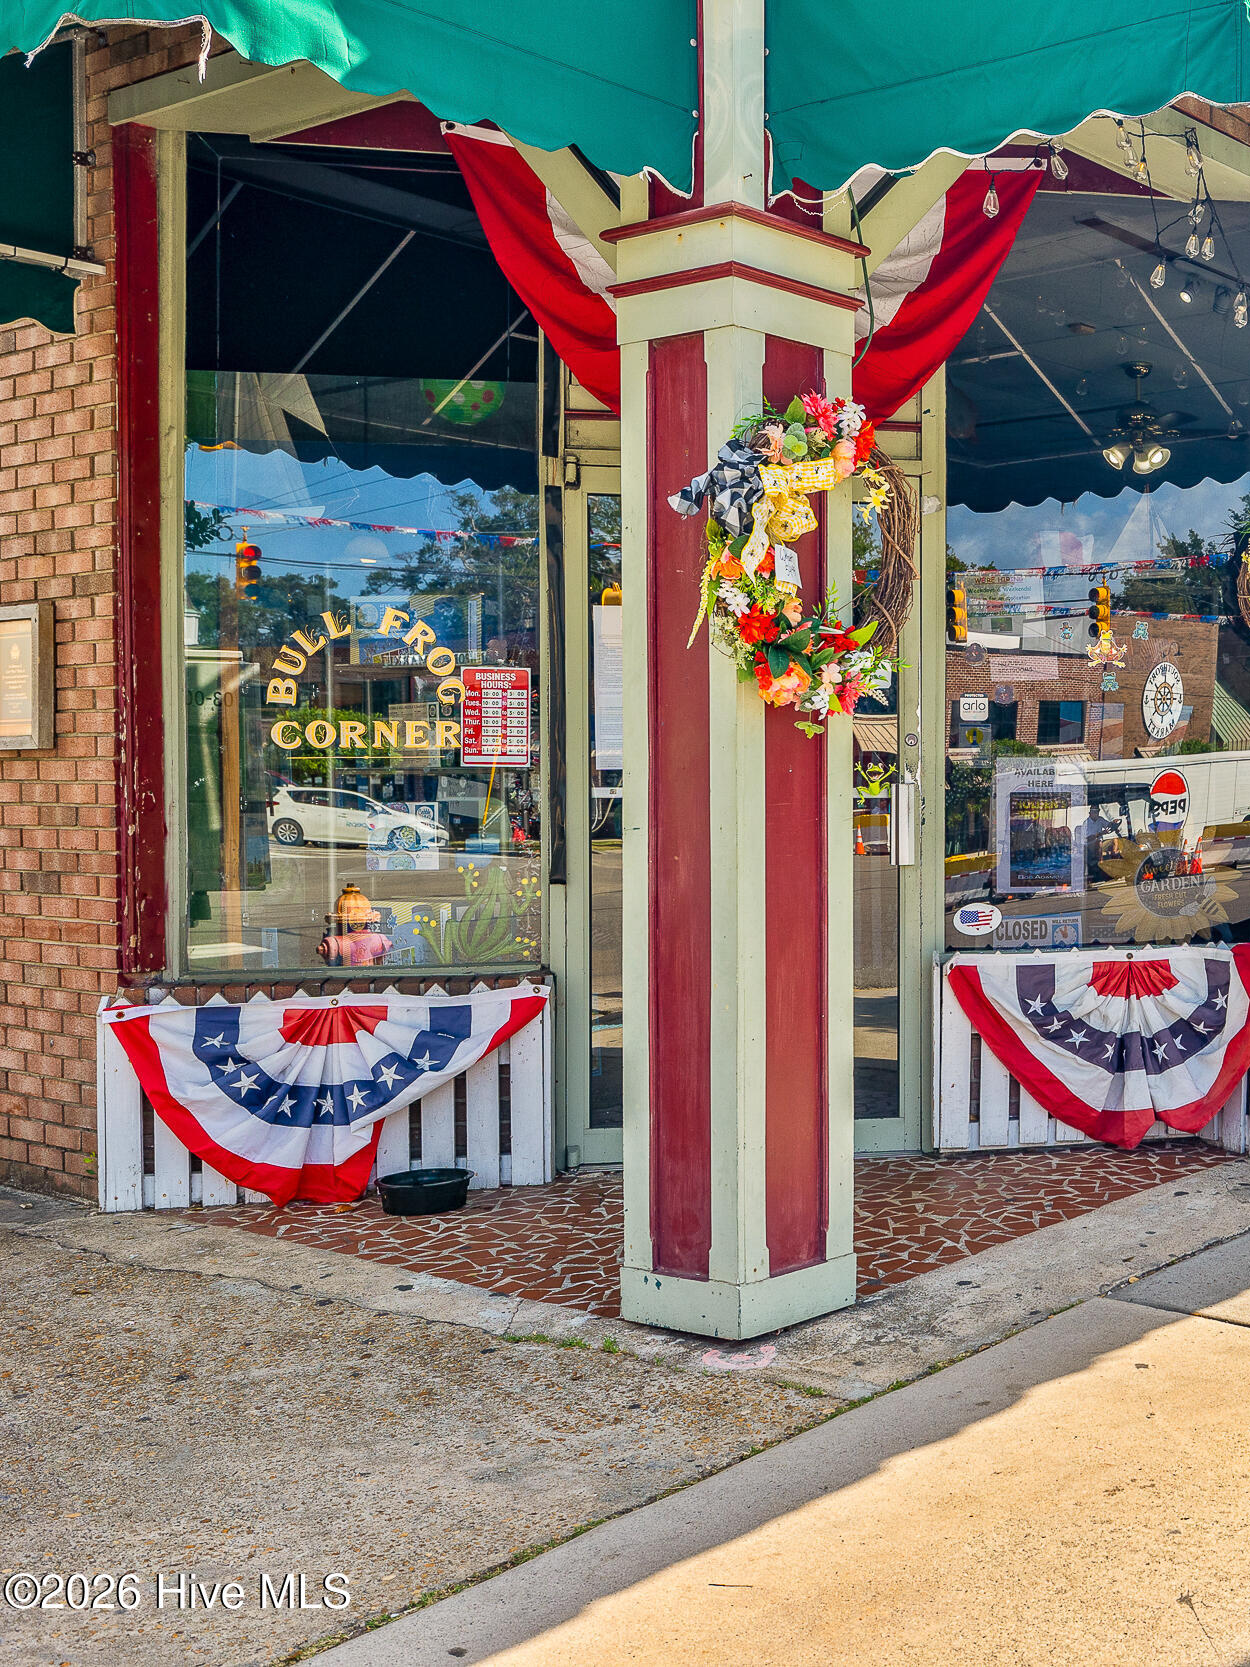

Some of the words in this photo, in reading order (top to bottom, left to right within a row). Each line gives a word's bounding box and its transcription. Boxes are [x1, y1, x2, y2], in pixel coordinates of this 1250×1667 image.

[266, 609, 354, 706] BULL
[376, 606, 467, 707] FROG
[475, 672, 516, 681] BUSINESS
[480, 681, 512, 689] HOURS:
[962, 699, 986, 711] arlo
[270, 720, 462, 750] CORNER
[1014, 768, 1056, 777] AVAILAB
[1027, 780, 1054, 788] HERE
[995, 919, 1048, 942] CLOSED
